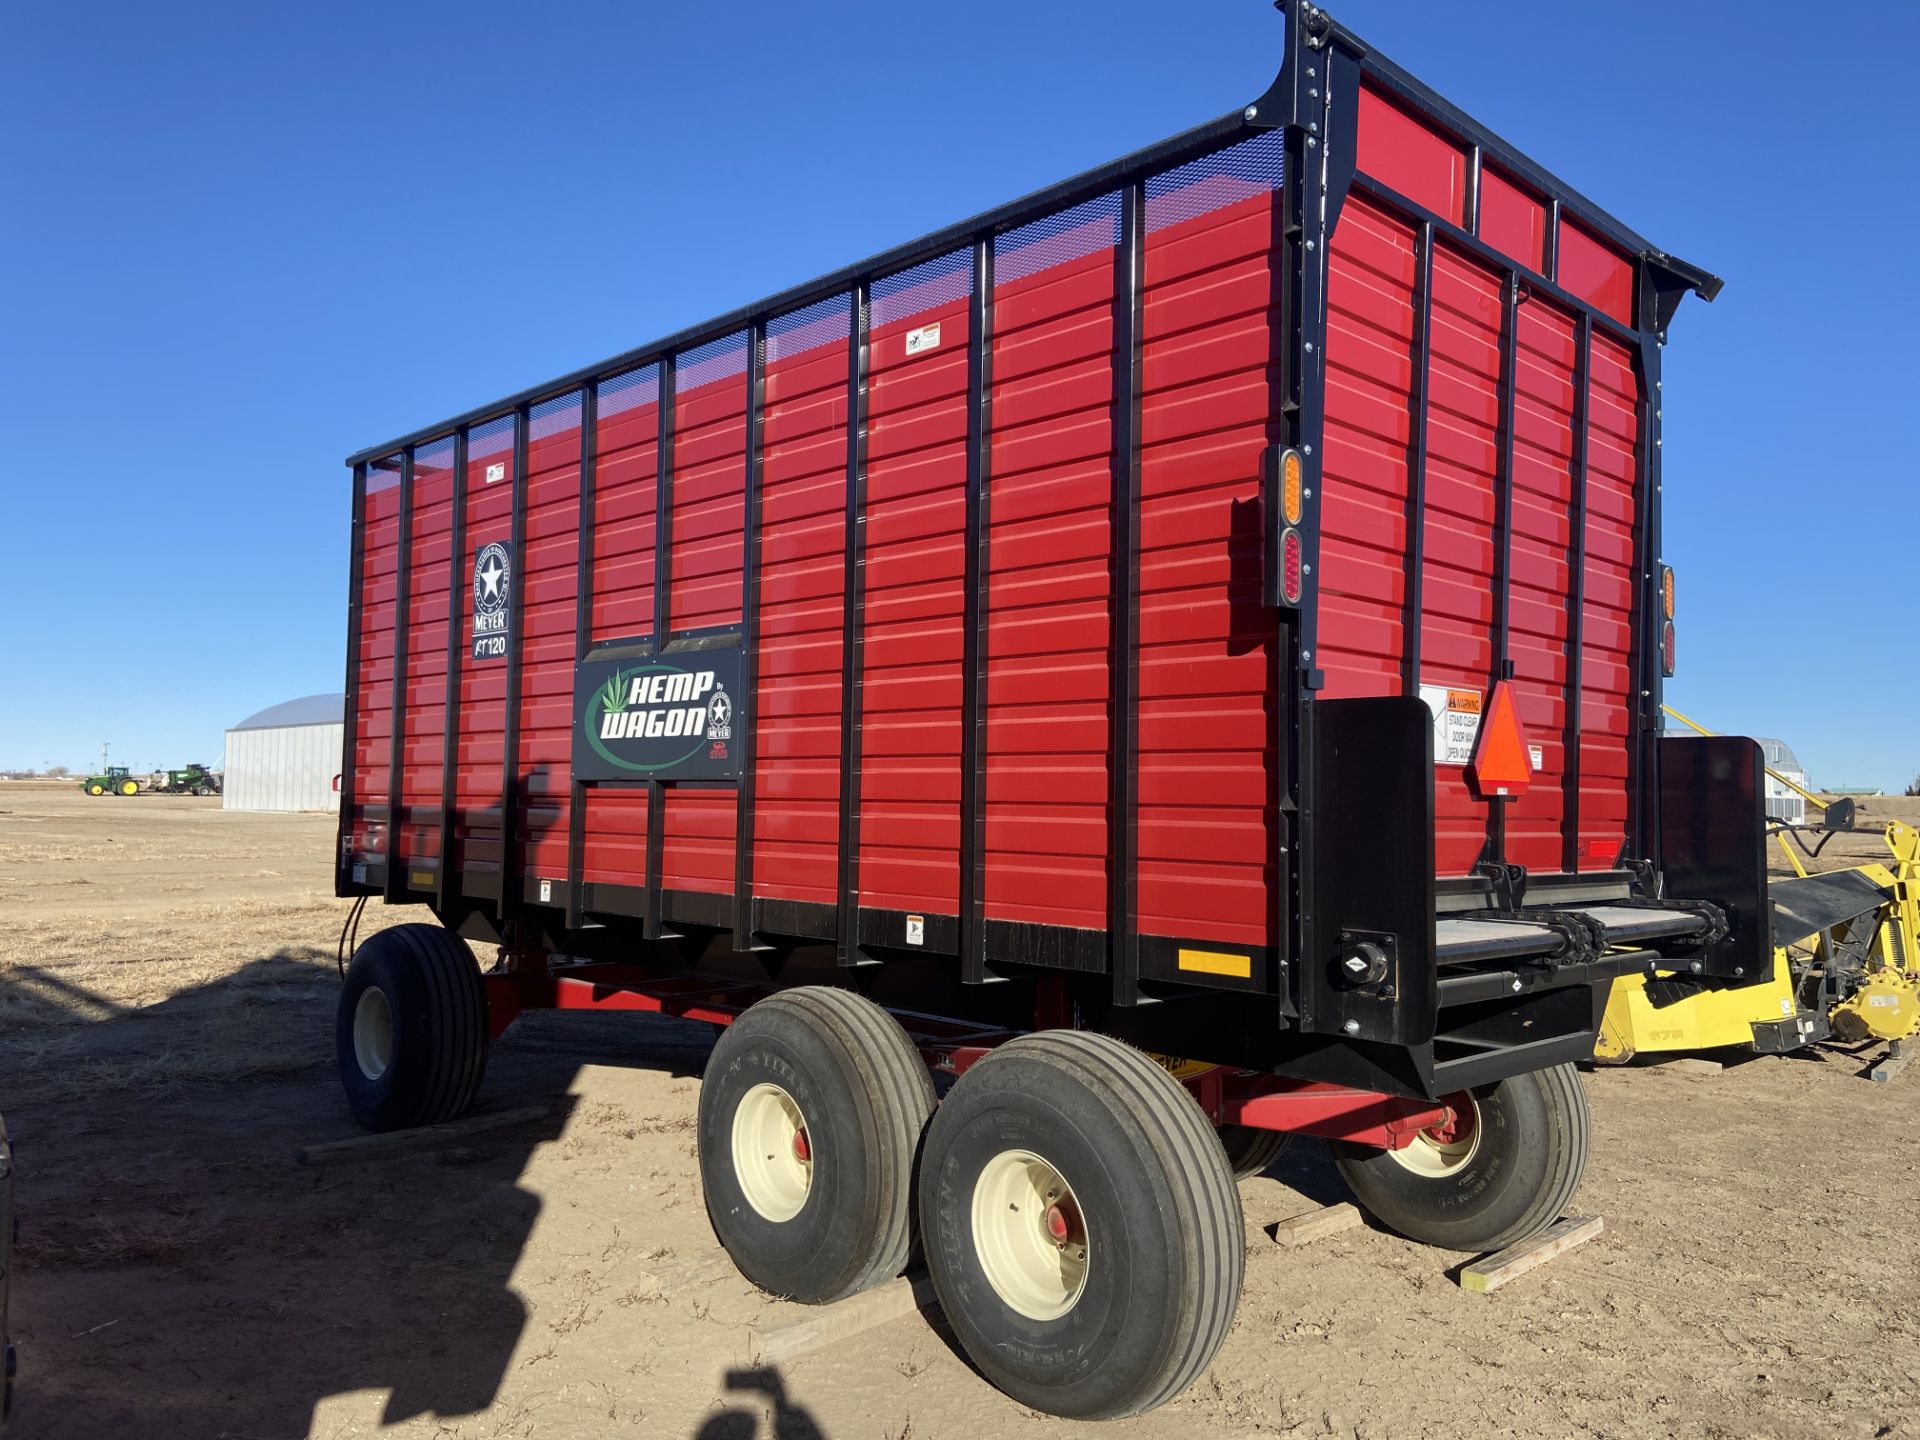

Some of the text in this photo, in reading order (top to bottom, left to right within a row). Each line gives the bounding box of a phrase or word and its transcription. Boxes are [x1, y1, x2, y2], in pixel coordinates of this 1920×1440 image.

[475, 611, 505, 631] MEYER
[629, 671, 715, 705] HEMP
[716, 682, 724, 693] By
[1456, 698, 1479, 711] WARNING
[600, 707, 707, 739] WAGON
[1449, 715, 1477, 727] STAND CLEAR
[709, 729, 729, 738] MEYER
[1453, 731, 1464, 742] DOOR
[1448, 747, 1459, 758] OPEN
